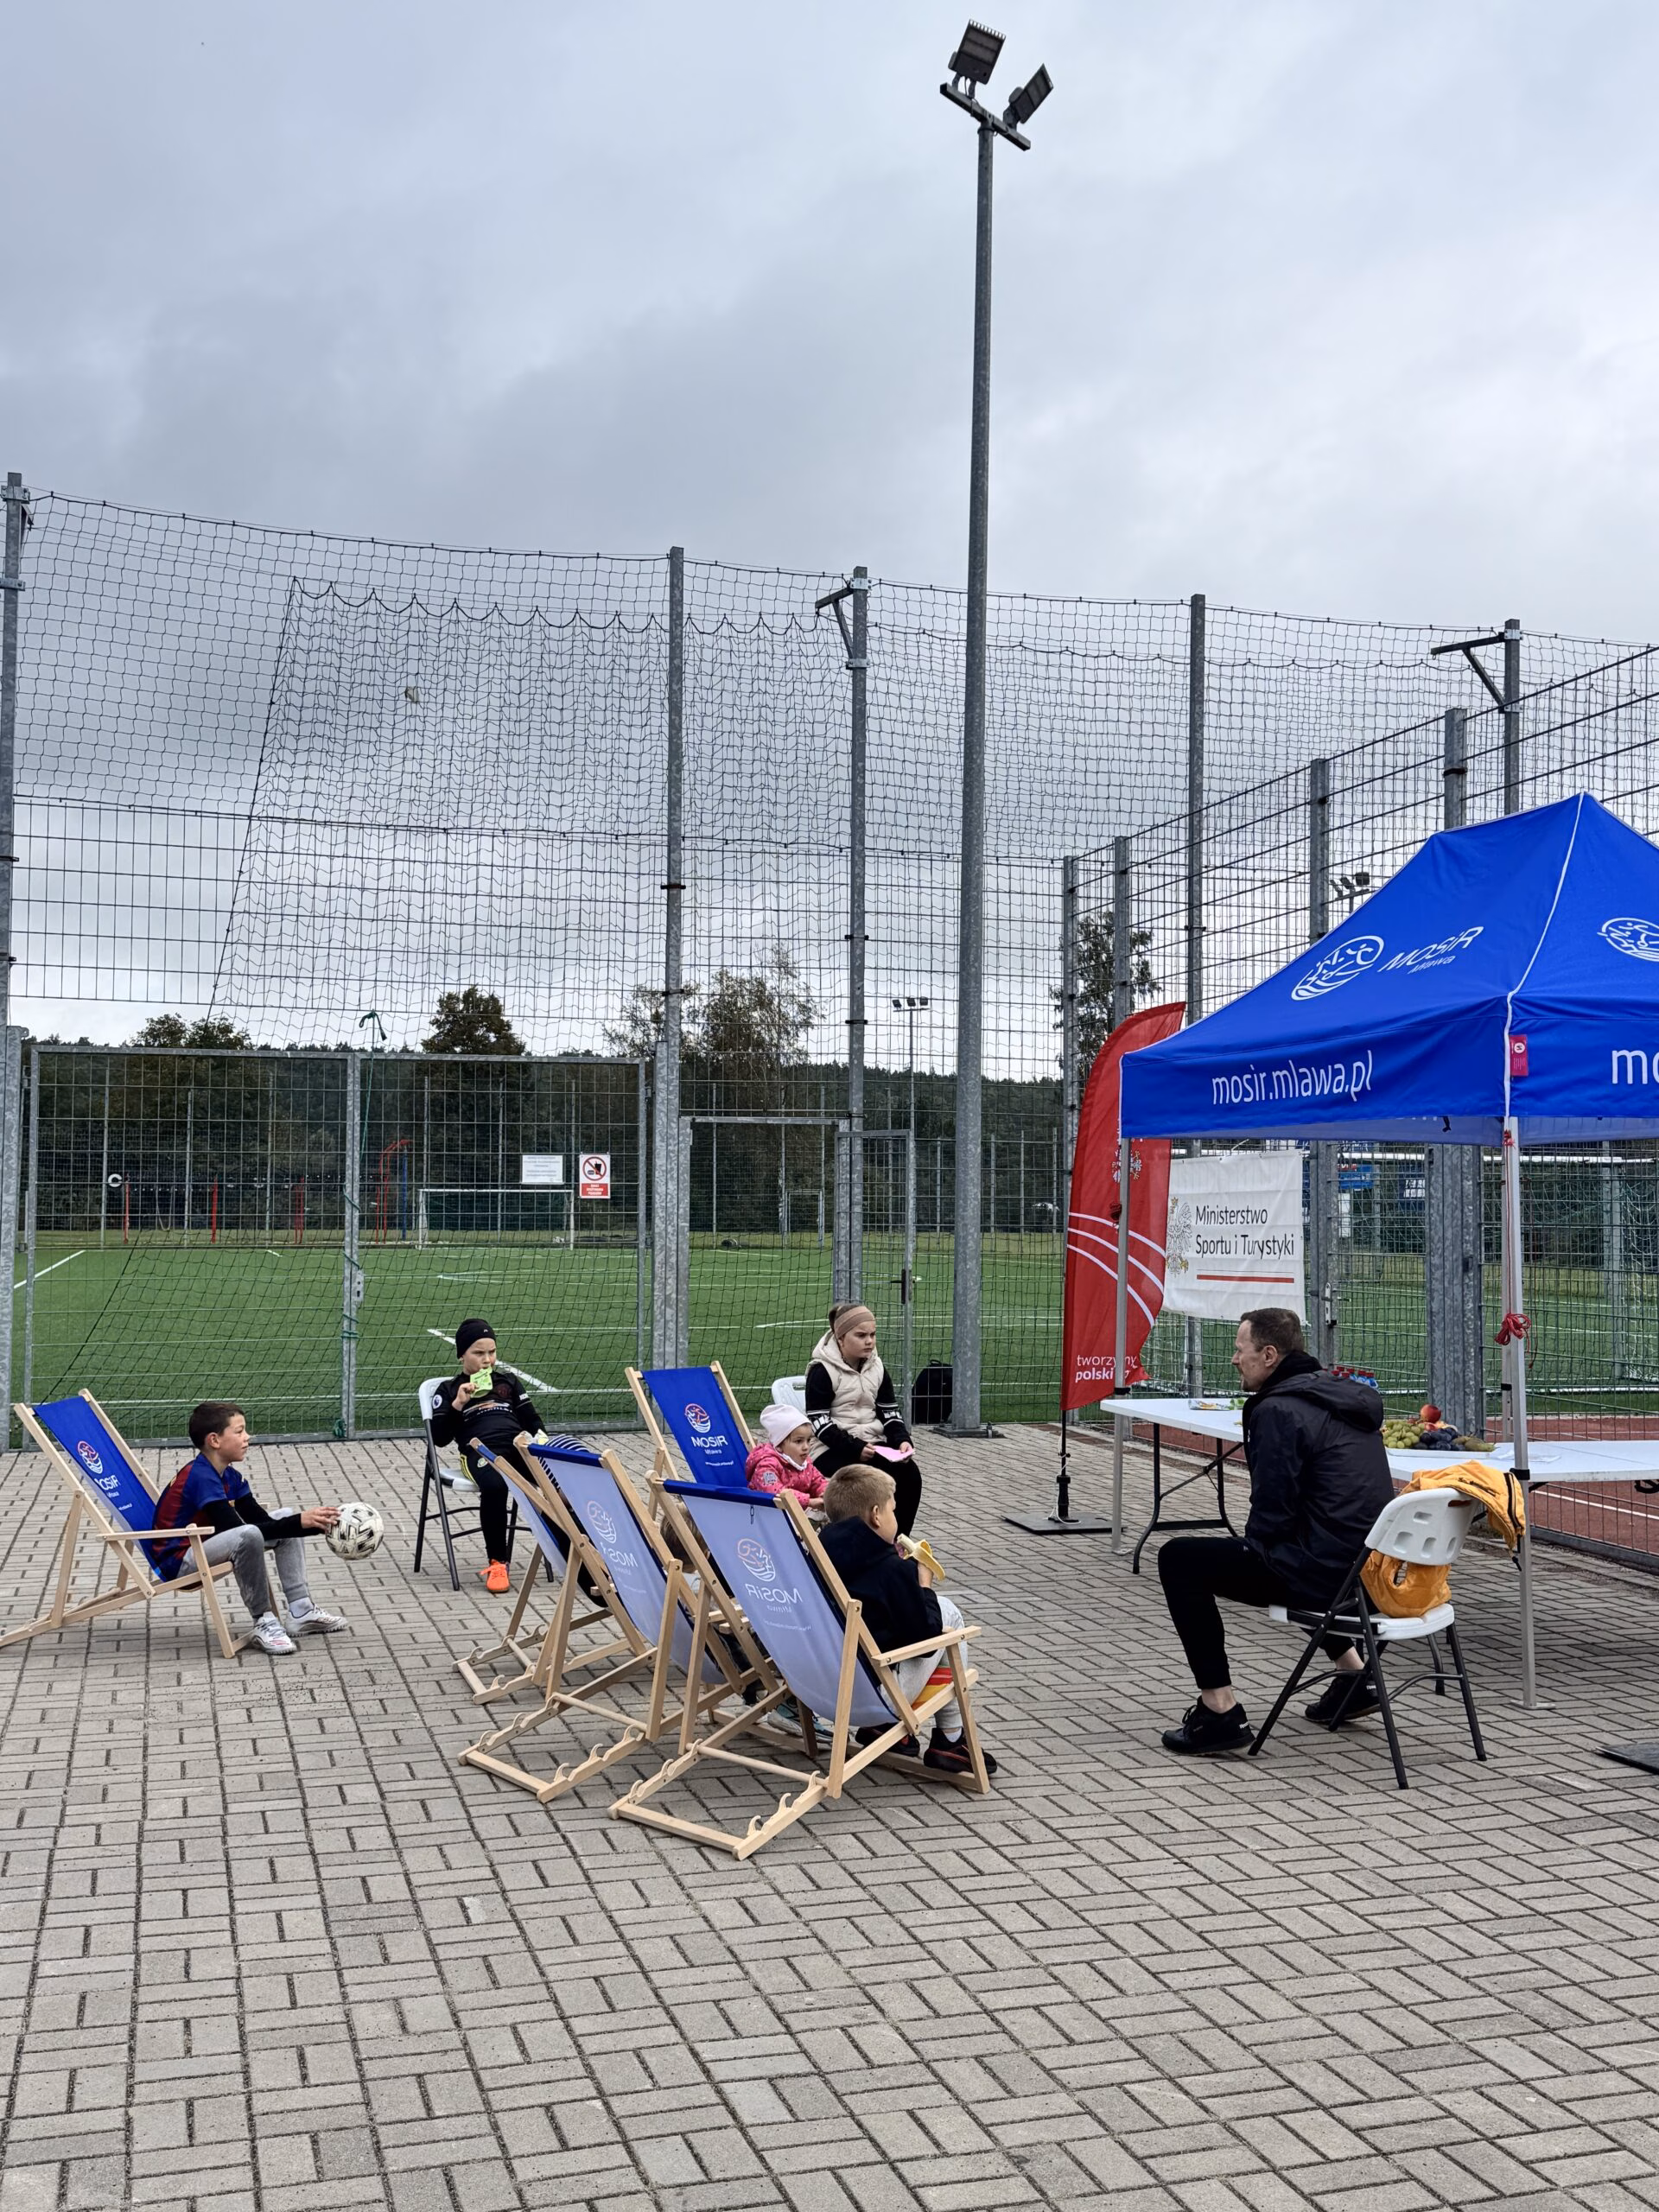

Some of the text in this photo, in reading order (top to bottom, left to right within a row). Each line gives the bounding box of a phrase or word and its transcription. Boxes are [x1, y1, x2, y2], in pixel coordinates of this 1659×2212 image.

[1211, 1050, 1373, 1105] mosir.mlawa.pl
[1195, 1205, 1268, 1225] Ministerstwo
[1195, 1233, 1295, 1260] Sportu i Turystyki
[1075, 1367, 1114, 1383] polski
